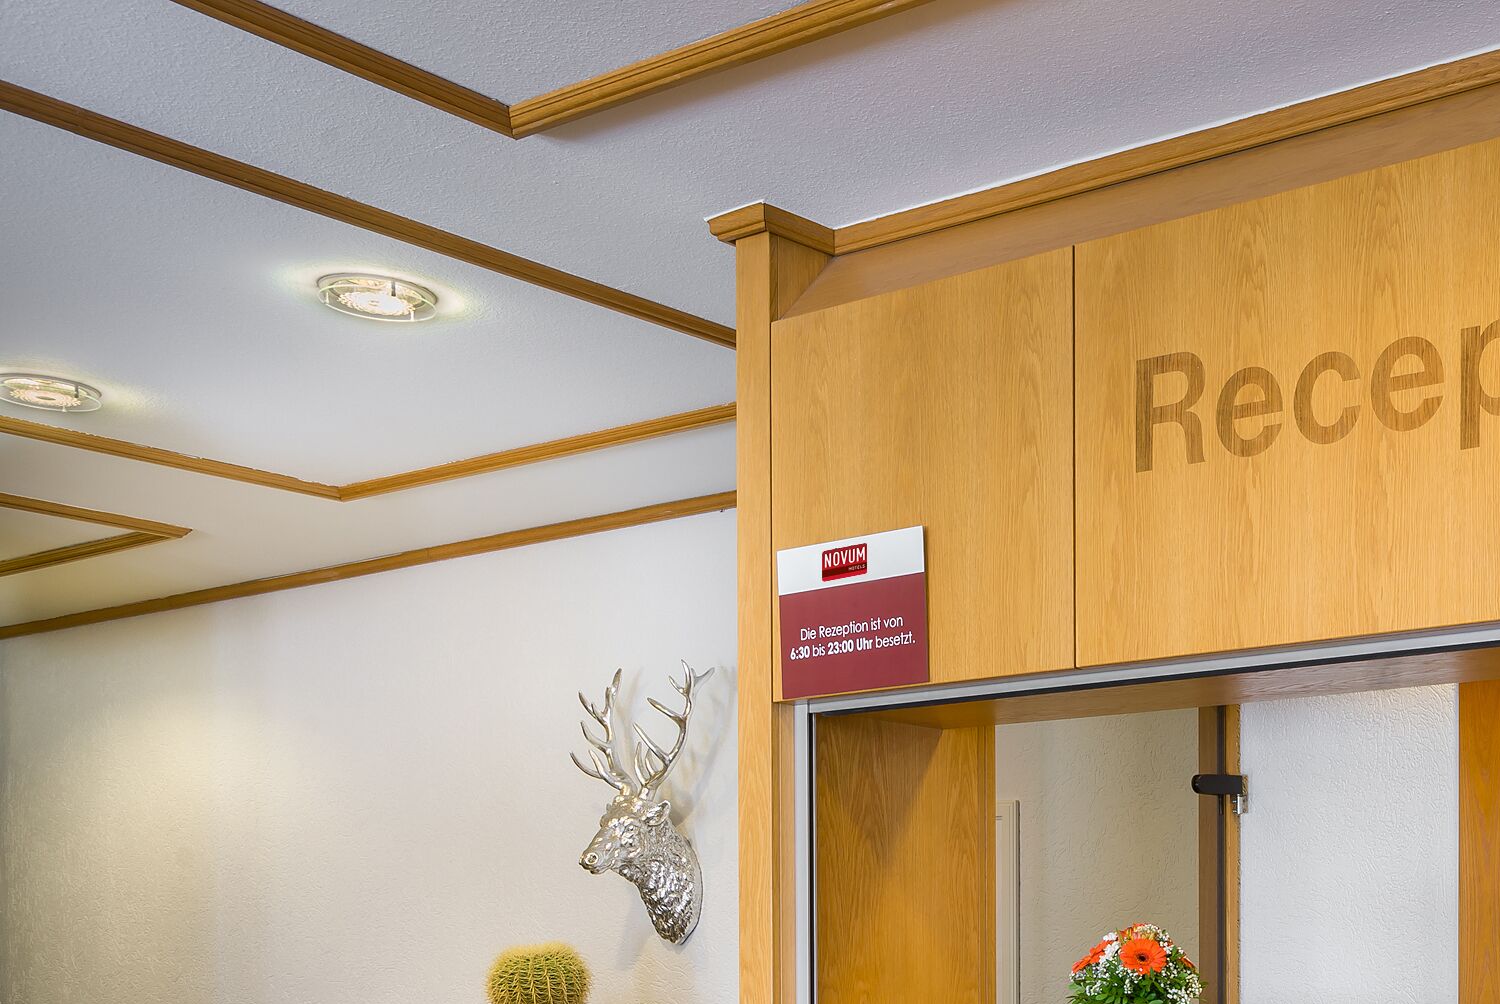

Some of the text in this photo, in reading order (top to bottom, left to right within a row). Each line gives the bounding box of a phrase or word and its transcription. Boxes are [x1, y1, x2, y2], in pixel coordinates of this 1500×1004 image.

[824, 546, 866, 568] NOVUM
[800, 616, 903, 641] Die Rezeption ist von
[790, 630, 916, 660] 6:30 bis 23:00 Uhr besetzt.
